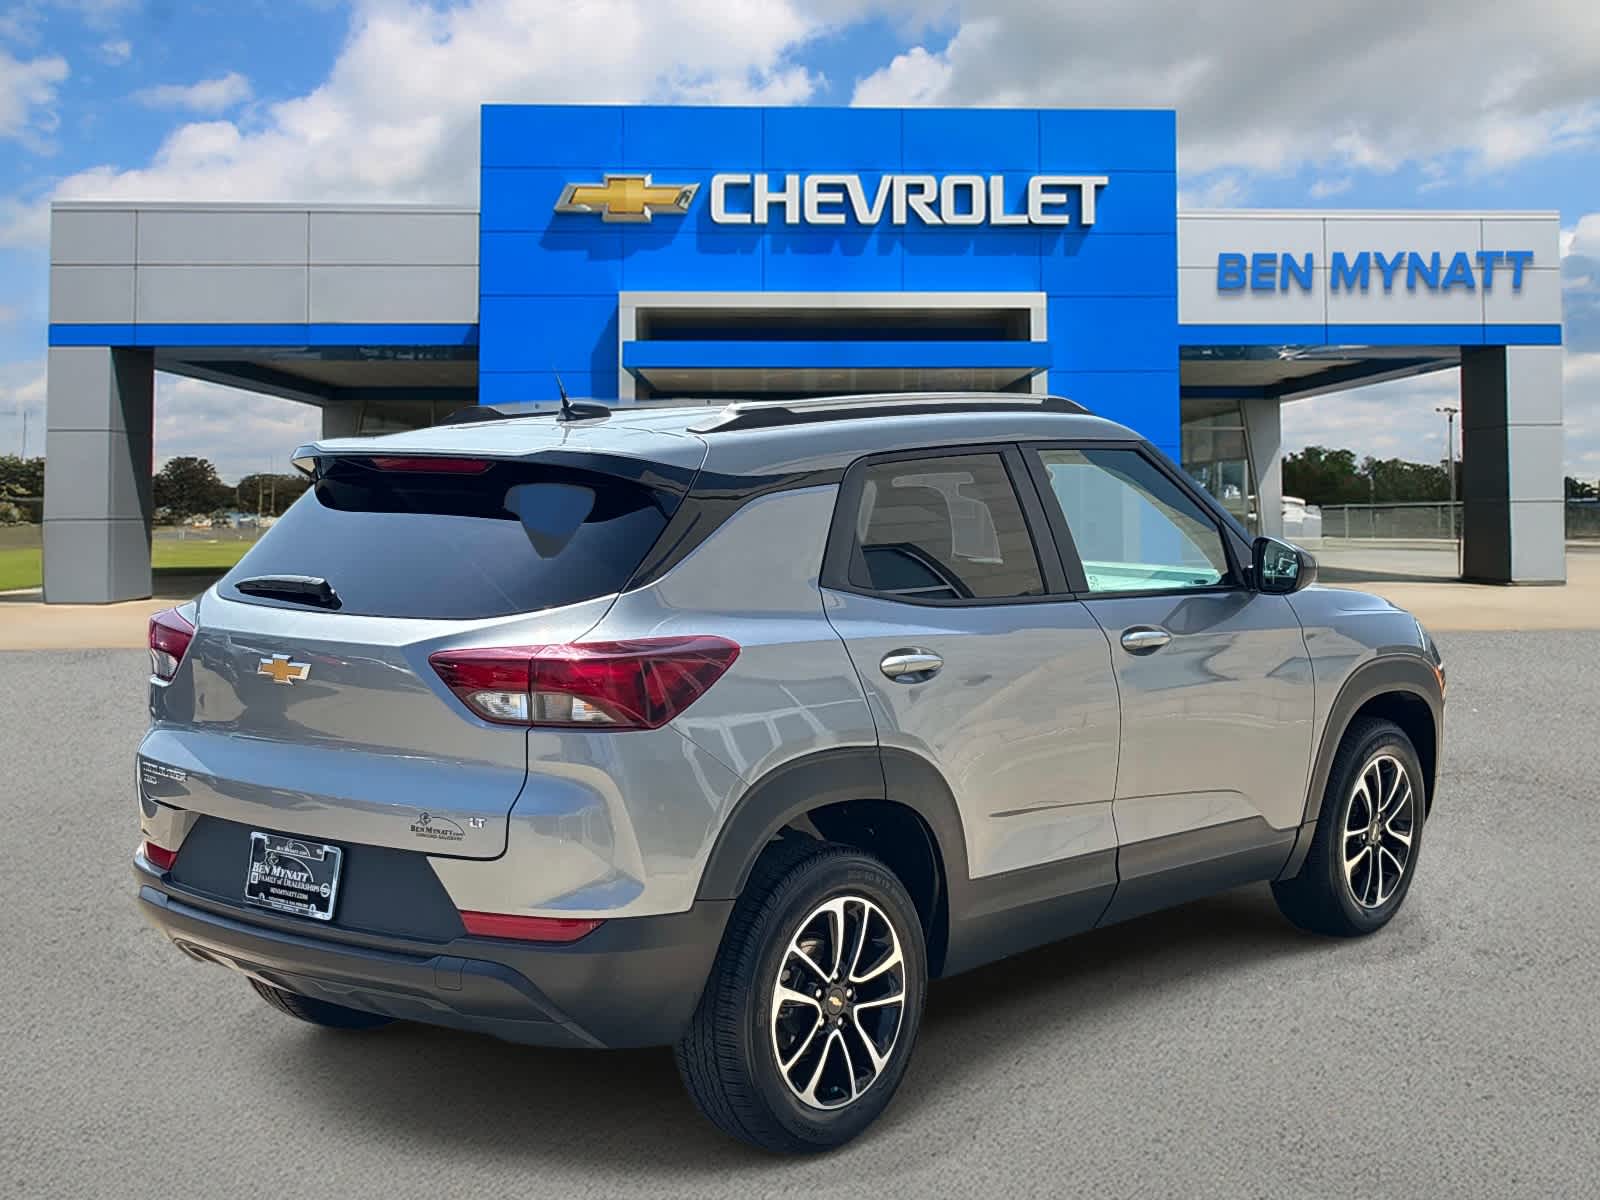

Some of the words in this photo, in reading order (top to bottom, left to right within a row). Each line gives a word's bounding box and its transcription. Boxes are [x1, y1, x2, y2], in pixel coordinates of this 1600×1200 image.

[710, 173, 1110, 225] CHEVROLET
[1217, 252, 1313, 290] BEN
[1330, 251, 1534, 290] MYNATT
[252, 862, 271, 875] BEN
[271, 866, 309, 882] MYNATT
